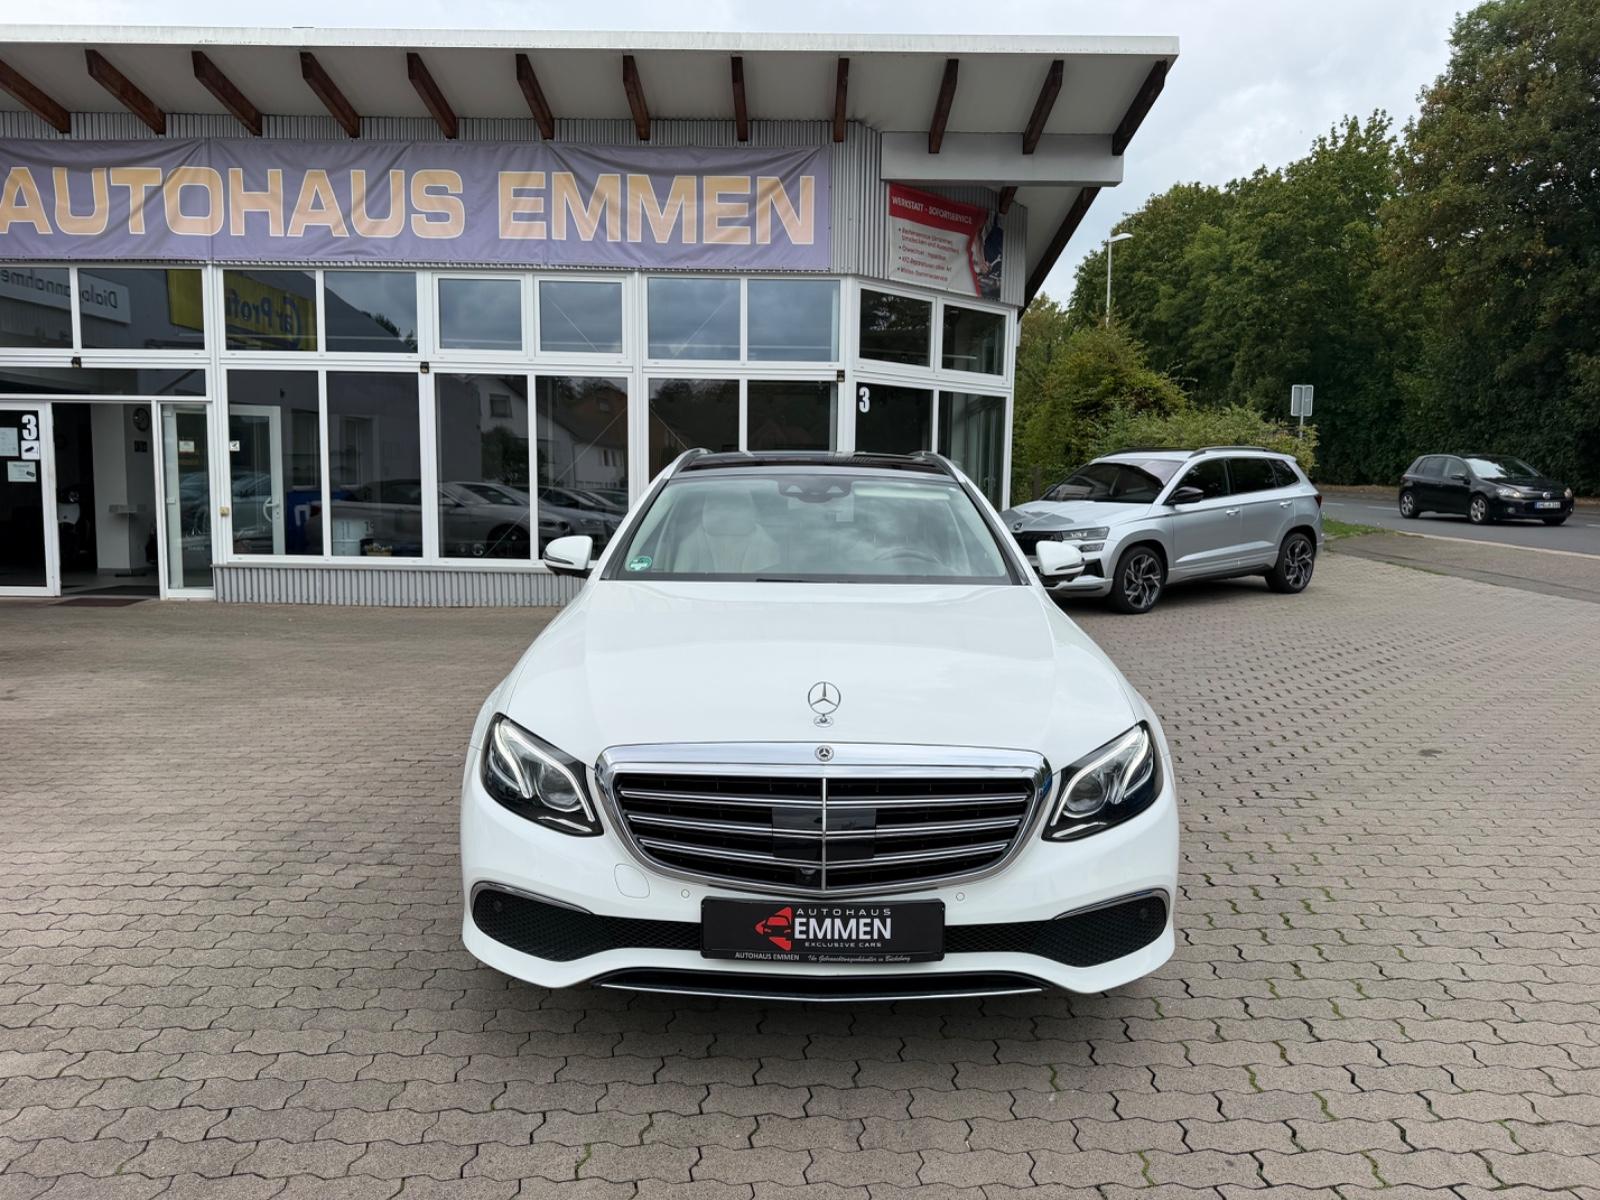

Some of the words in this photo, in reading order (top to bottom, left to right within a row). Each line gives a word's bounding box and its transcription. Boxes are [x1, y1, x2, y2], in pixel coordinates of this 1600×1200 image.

[0, 167, 465, 239] AUTOHAUS
[498, 171, 814, 245] EMMEN
[892, 196, 924, 212] WERKSTATT
[859, 386, 870, 413] 3
[21, 414, 38, 440] 3
[796, 908, 891, 916] AUTOHAUS
[794, 918, 892, 940] EMMEN
[735, 952, 772, 961] AUTOHAUS
[773, 953, 800, 961] EMMEN
